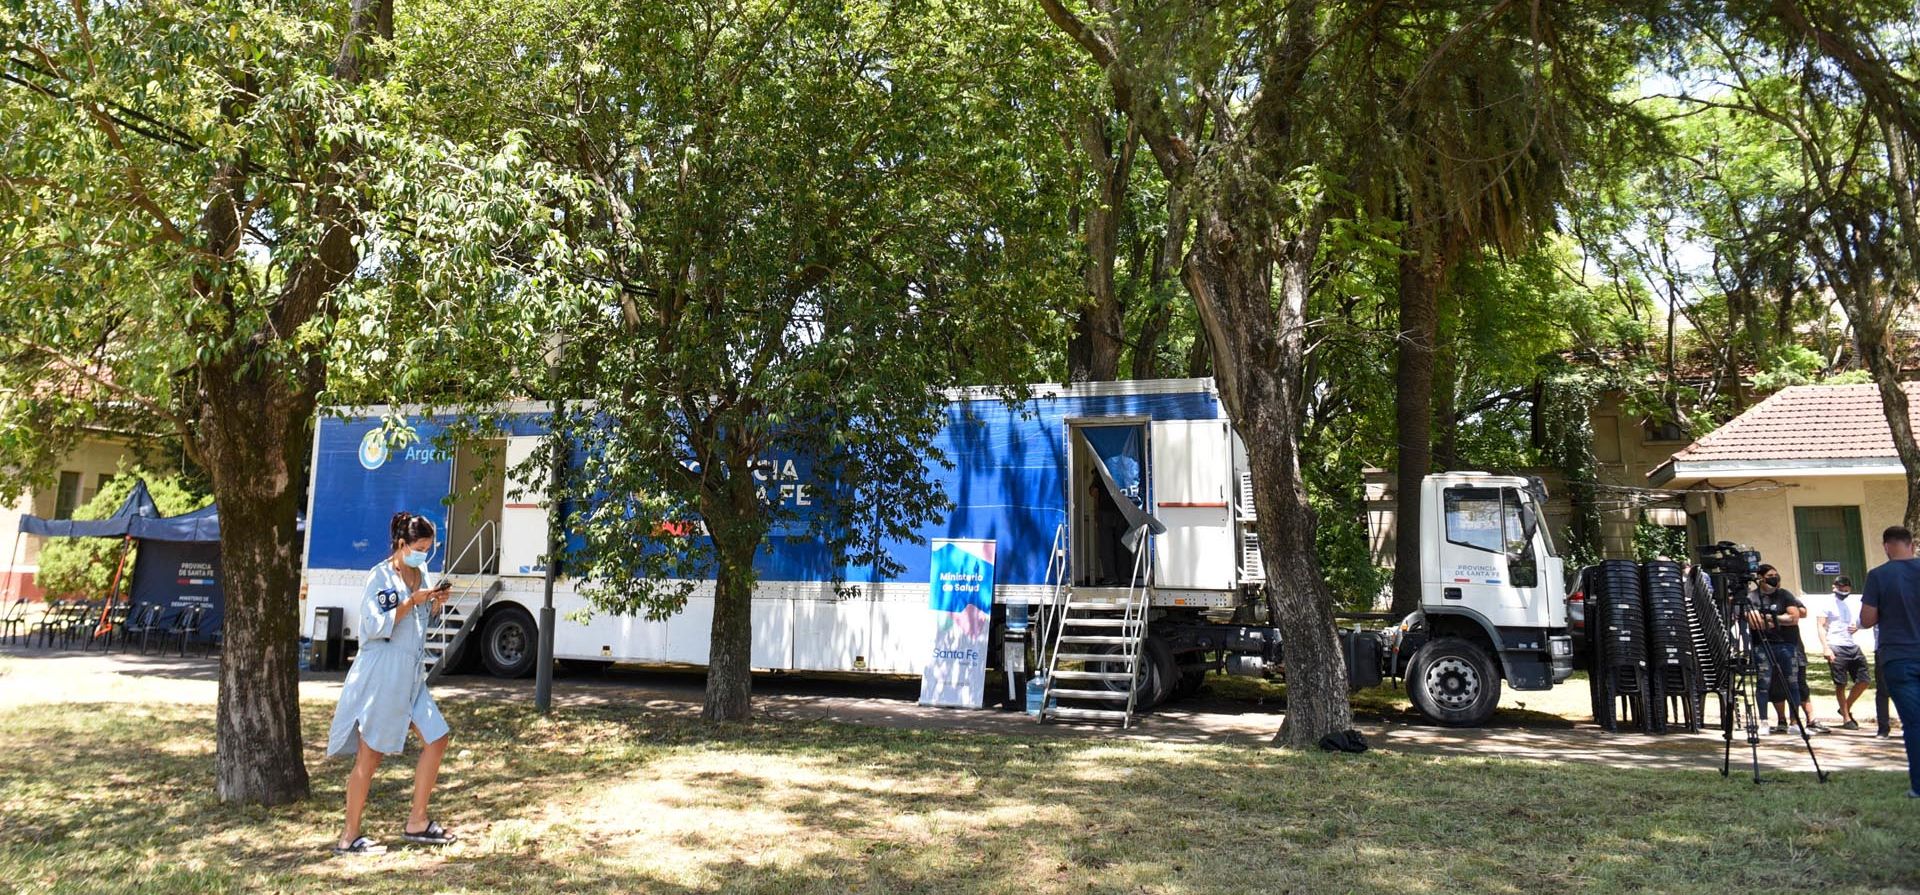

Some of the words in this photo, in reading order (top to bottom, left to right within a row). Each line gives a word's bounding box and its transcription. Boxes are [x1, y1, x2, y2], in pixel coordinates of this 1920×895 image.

[940, 572, 984, 582] Ministerio
[943, 583, 953, 592] de
[954, 583, 980, 592] Salud
[933, 647, 964, 660] Santa
[965, 649, 979, 660] Fe
